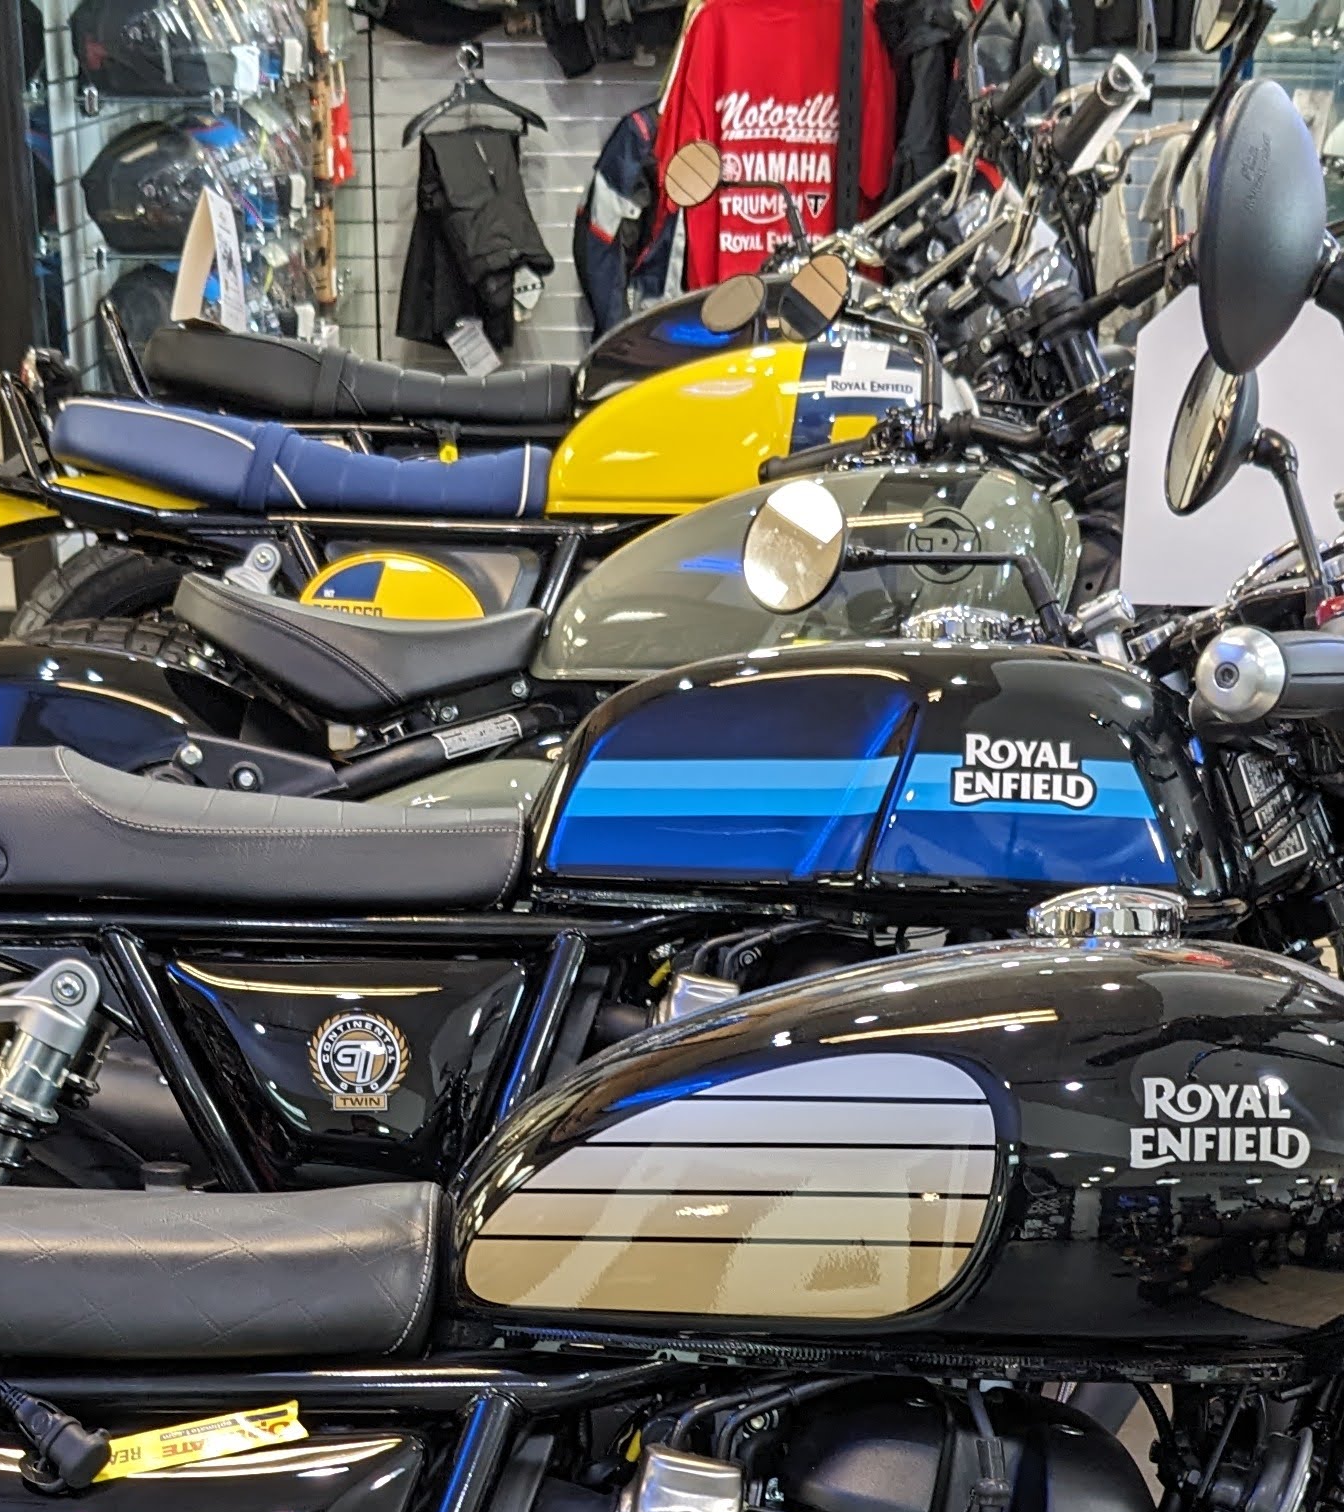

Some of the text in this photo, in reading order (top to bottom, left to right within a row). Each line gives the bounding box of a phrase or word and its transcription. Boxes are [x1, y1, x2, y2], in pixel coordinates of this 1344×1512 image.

[742, 152, 831, 183] YAMAHA
[719, 231, 764, 253] ROYAL
[831, 380, 913, 394] ROYAL ENFIELD
[965, 733, 1079, 770] ROYAL
[954, 771, 1094, 807] ENFIELD
[322, 1020, 396, 1064] CONTINENTAL
[340, 1097, 381, 1107] TWIN
[1142, 1077, 1292, 1123] ROYAL
[1130, 1127, 1311, 1169] ENFIELD
